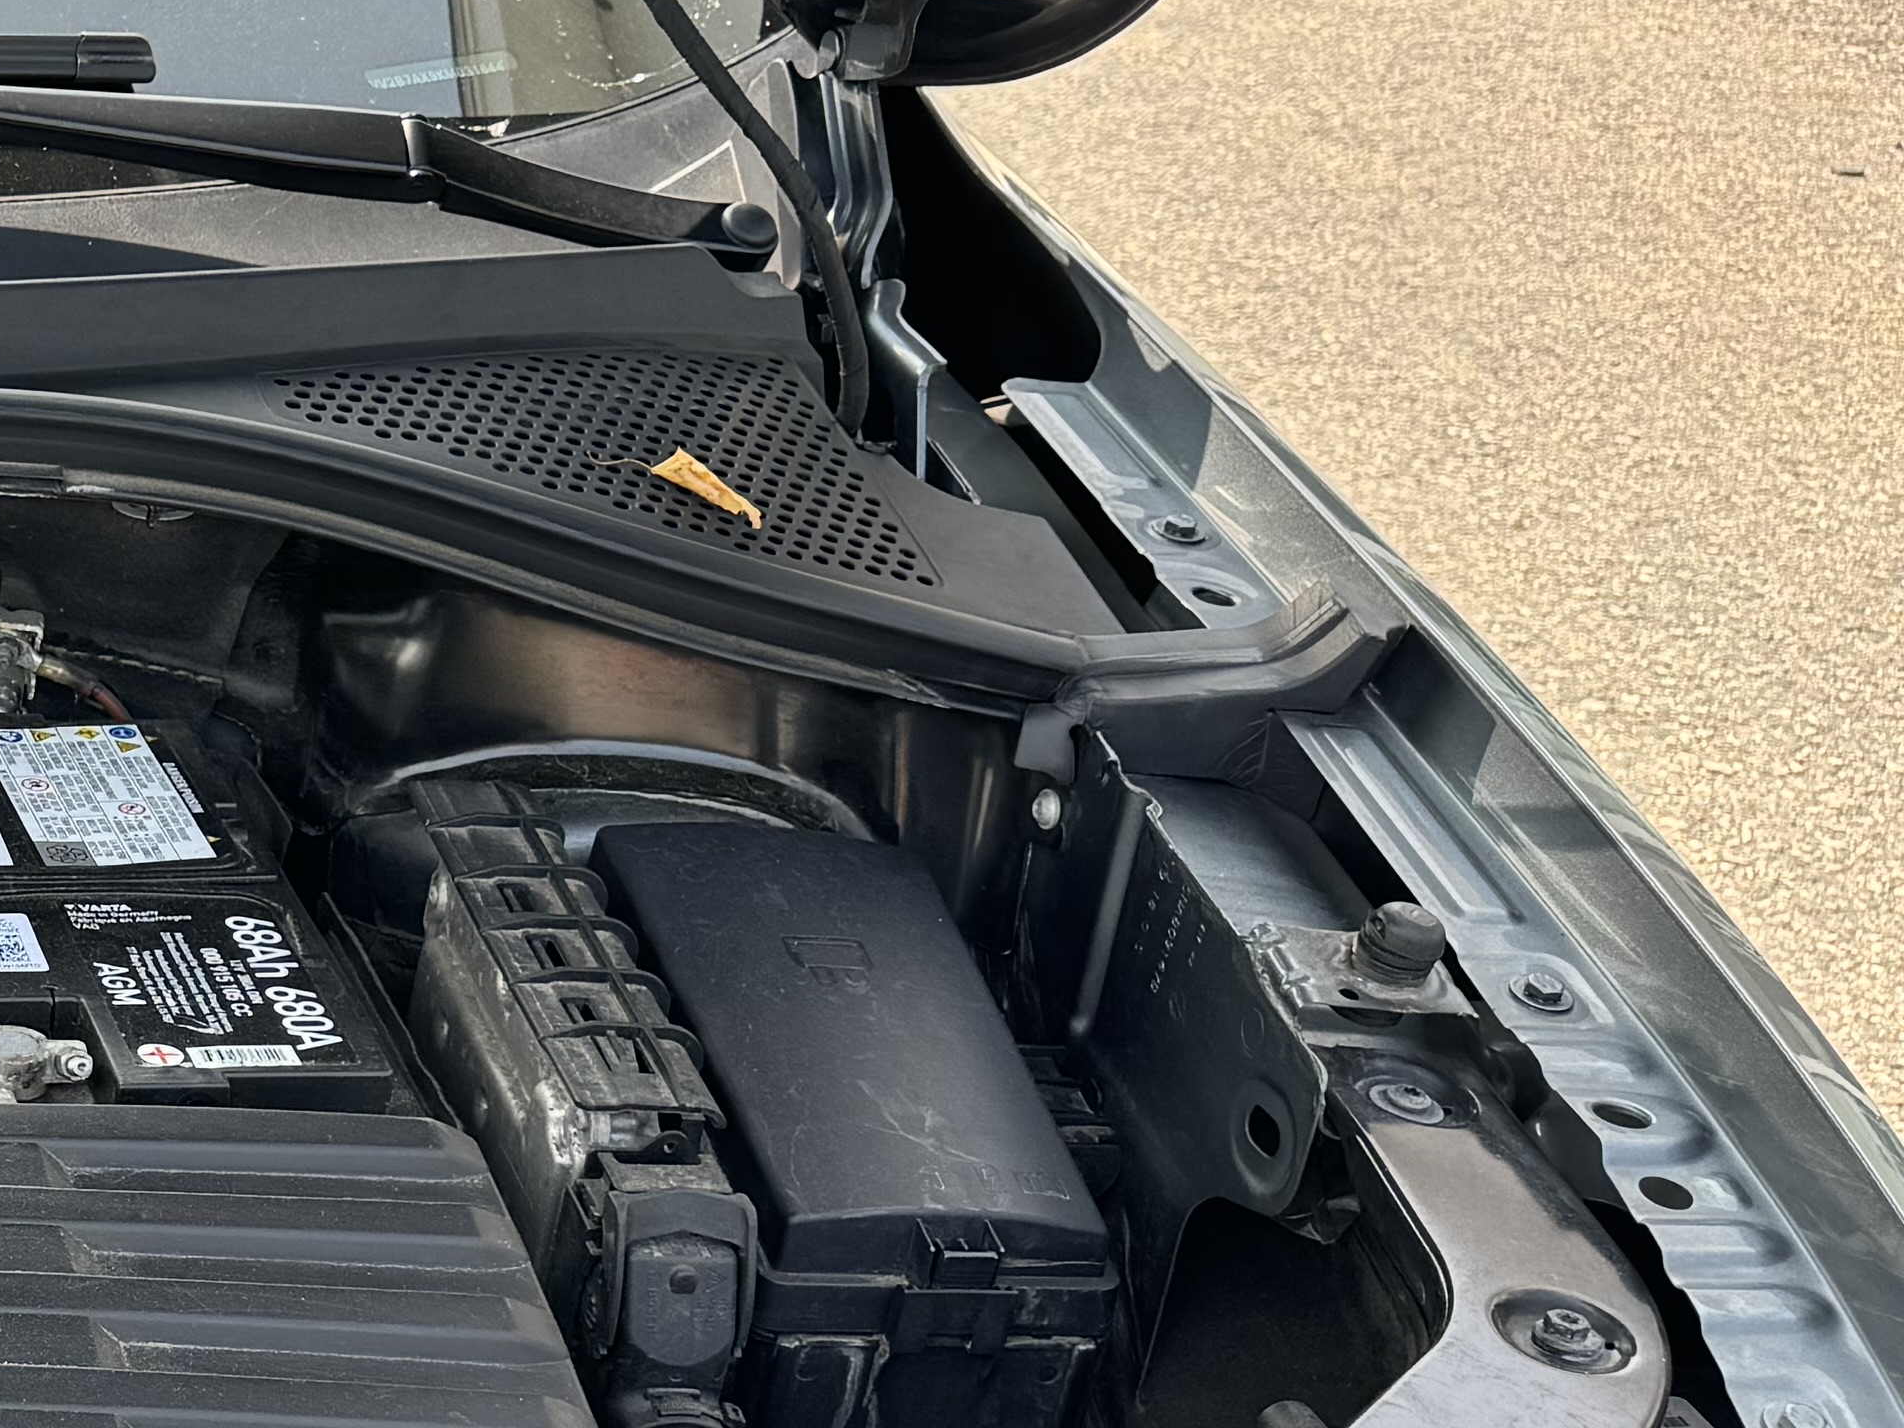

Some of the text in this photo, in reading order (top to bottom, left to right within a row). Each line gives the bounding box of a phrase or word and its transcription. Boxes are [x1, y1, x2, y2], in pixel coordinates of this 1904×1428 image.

[78, 904, 131, 912] VARTA
[93, 962, 147, 1006] AGM
[225, 916, 300, 979] 68Ah
[265, 986, 343, 1051] 680A
